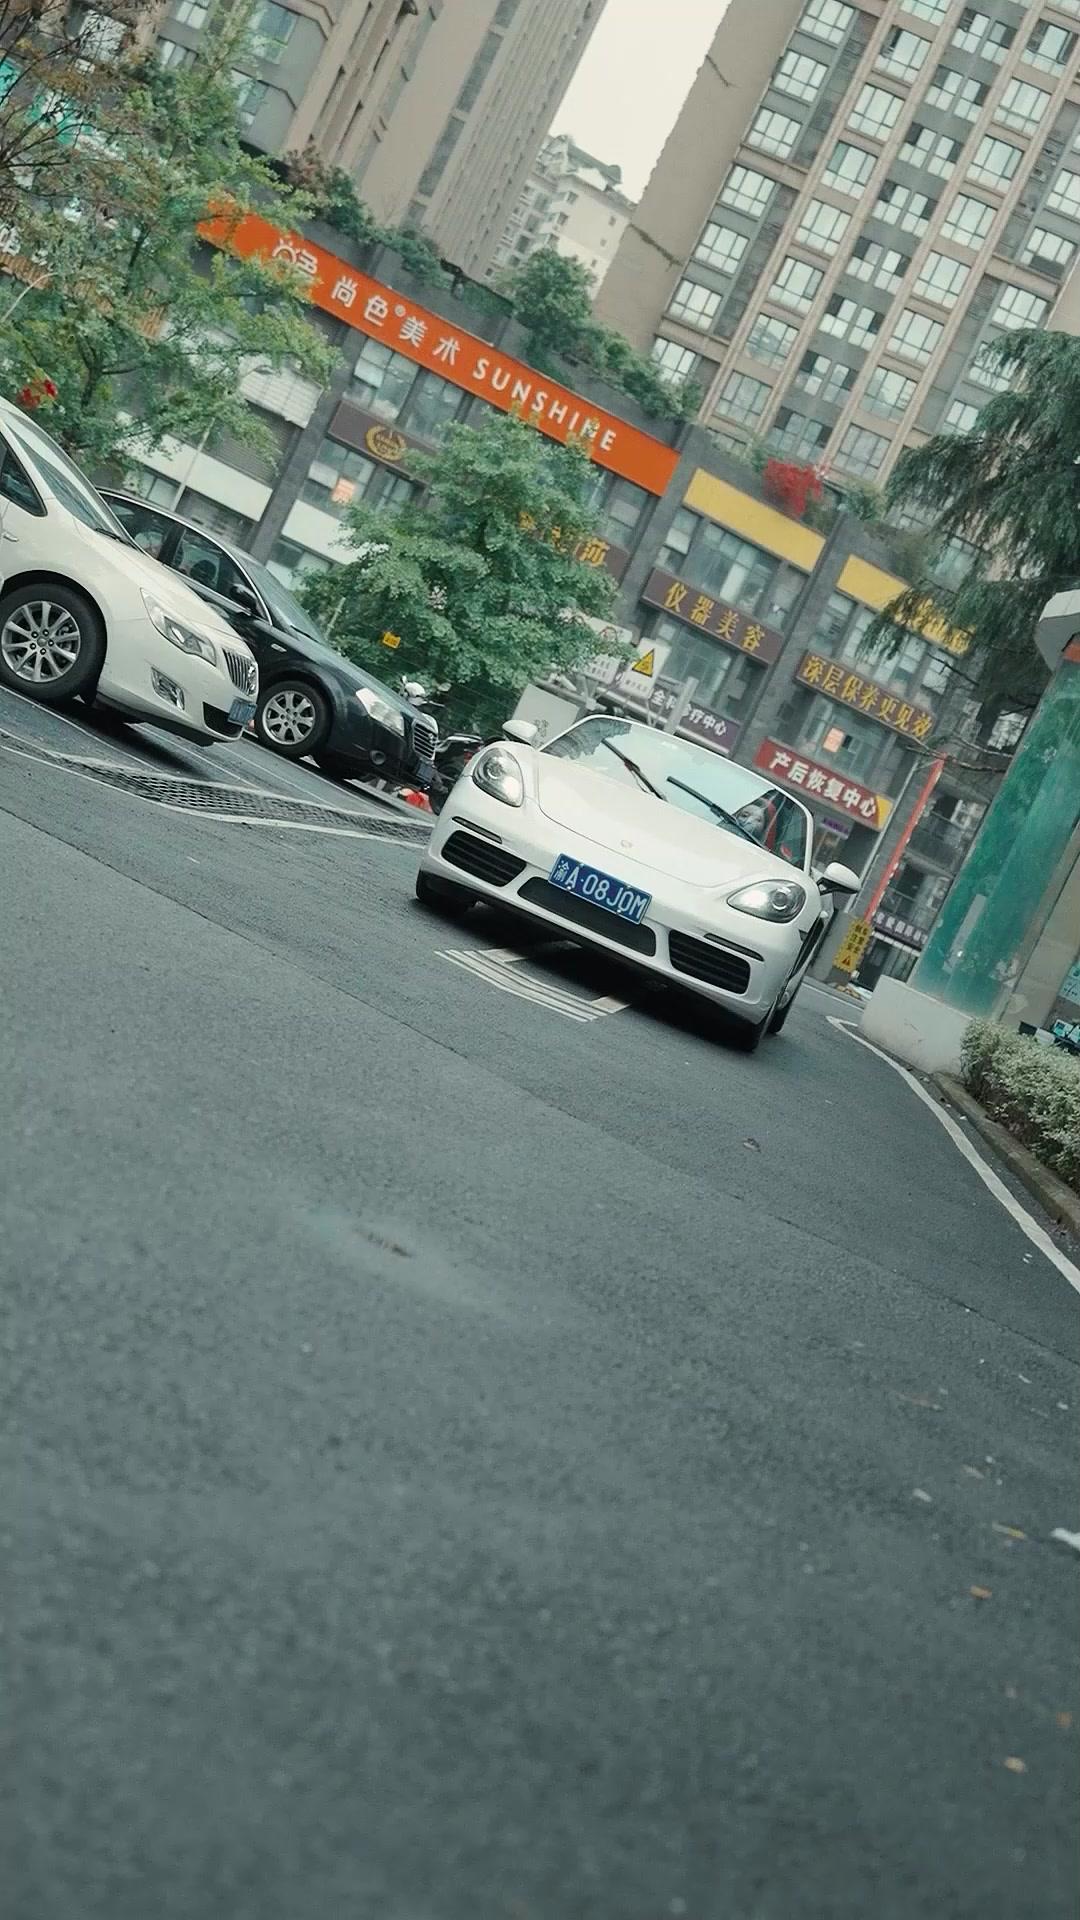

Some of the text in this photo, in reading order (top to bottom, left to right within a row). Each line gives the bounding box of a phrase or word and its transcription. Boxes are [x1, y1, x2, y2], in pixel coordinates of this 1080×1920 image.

[472, 358, 617, 452] SUNSHINE
[663, 581, 766, 652] 仪器美容
[801, 655, 935, 740] 深层保养更见效
[768, 750, 877, 819] 产后恢复中心
